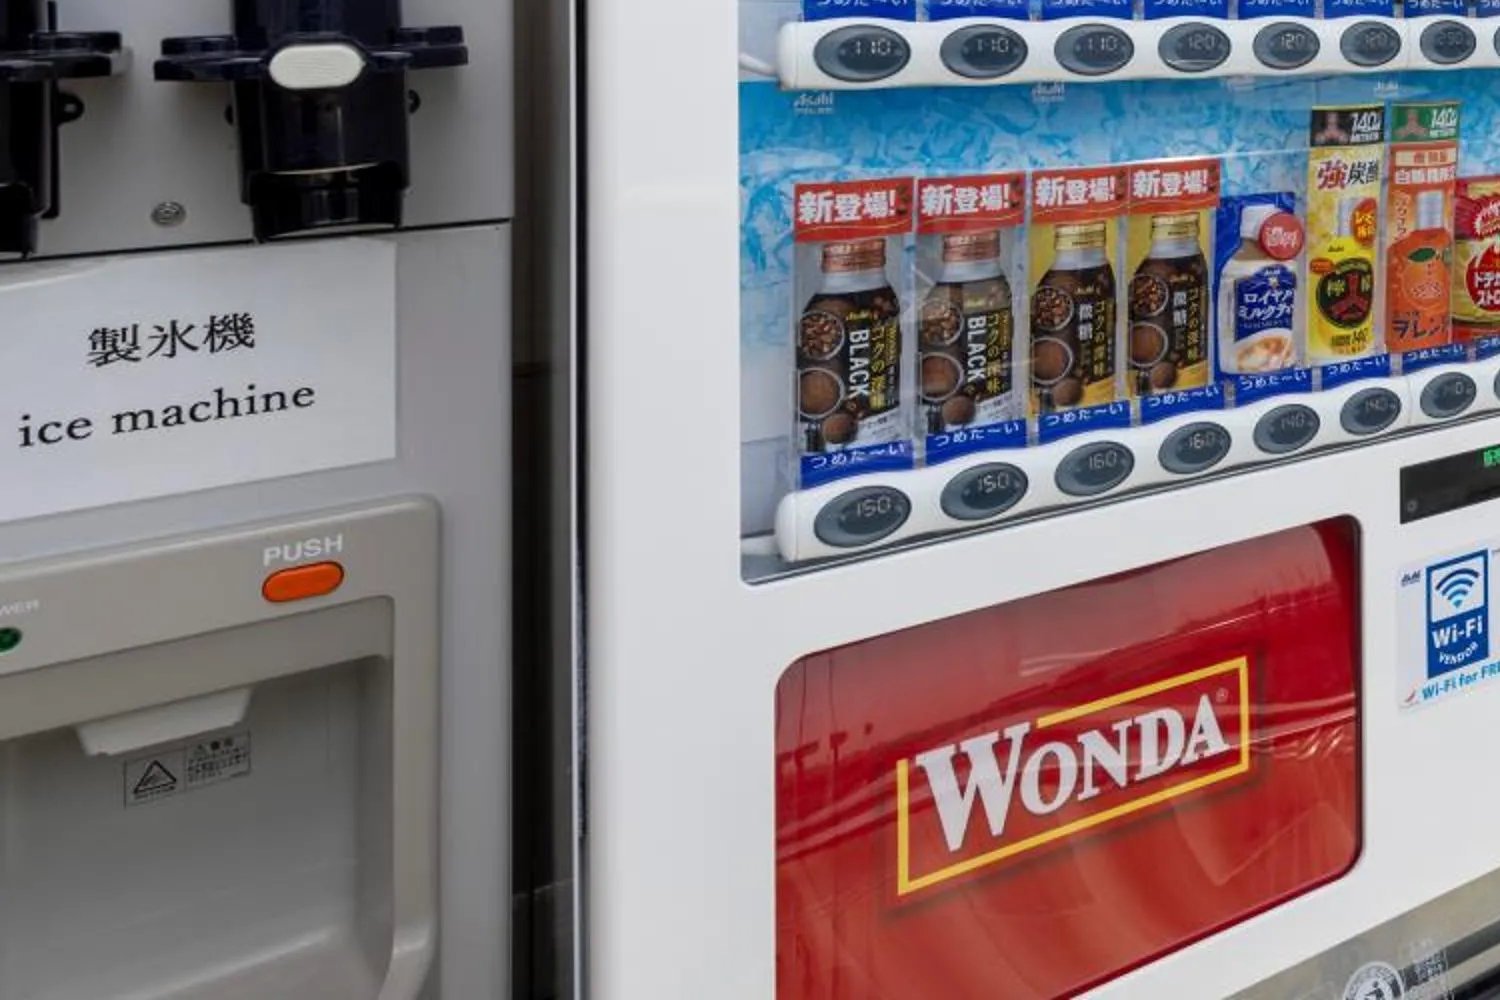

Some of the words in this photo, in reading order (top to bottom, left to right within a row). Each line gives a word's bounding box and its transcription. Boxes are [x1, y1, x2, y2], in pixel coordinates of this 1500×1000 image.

[920, 182, 1010, 217] 新登場!
[1034, 174, 1116, 207] 新登場!
[1132, 168, 1210, 199] 新登場!
[797, 188, 897, 224] 新登場!
[87, 311, 257, 369] 製氷機
[967, 315, 987, 384] BLACK
[849, 327, 870, 398] BLACK
[18, 414, 93, 447] ice
[111, 383, 317, 435] machine
[262, 533, 344, 567] PUSH
[1432, 614, 1483, 649] Wi-Fi
[1439, 641, 1479, 665] VENDOR
[1422, 680, 1457, 701] Wi-Fi
[1459, 670, 1478, 687] for
[915, 693, 1231, 853] WONDA
